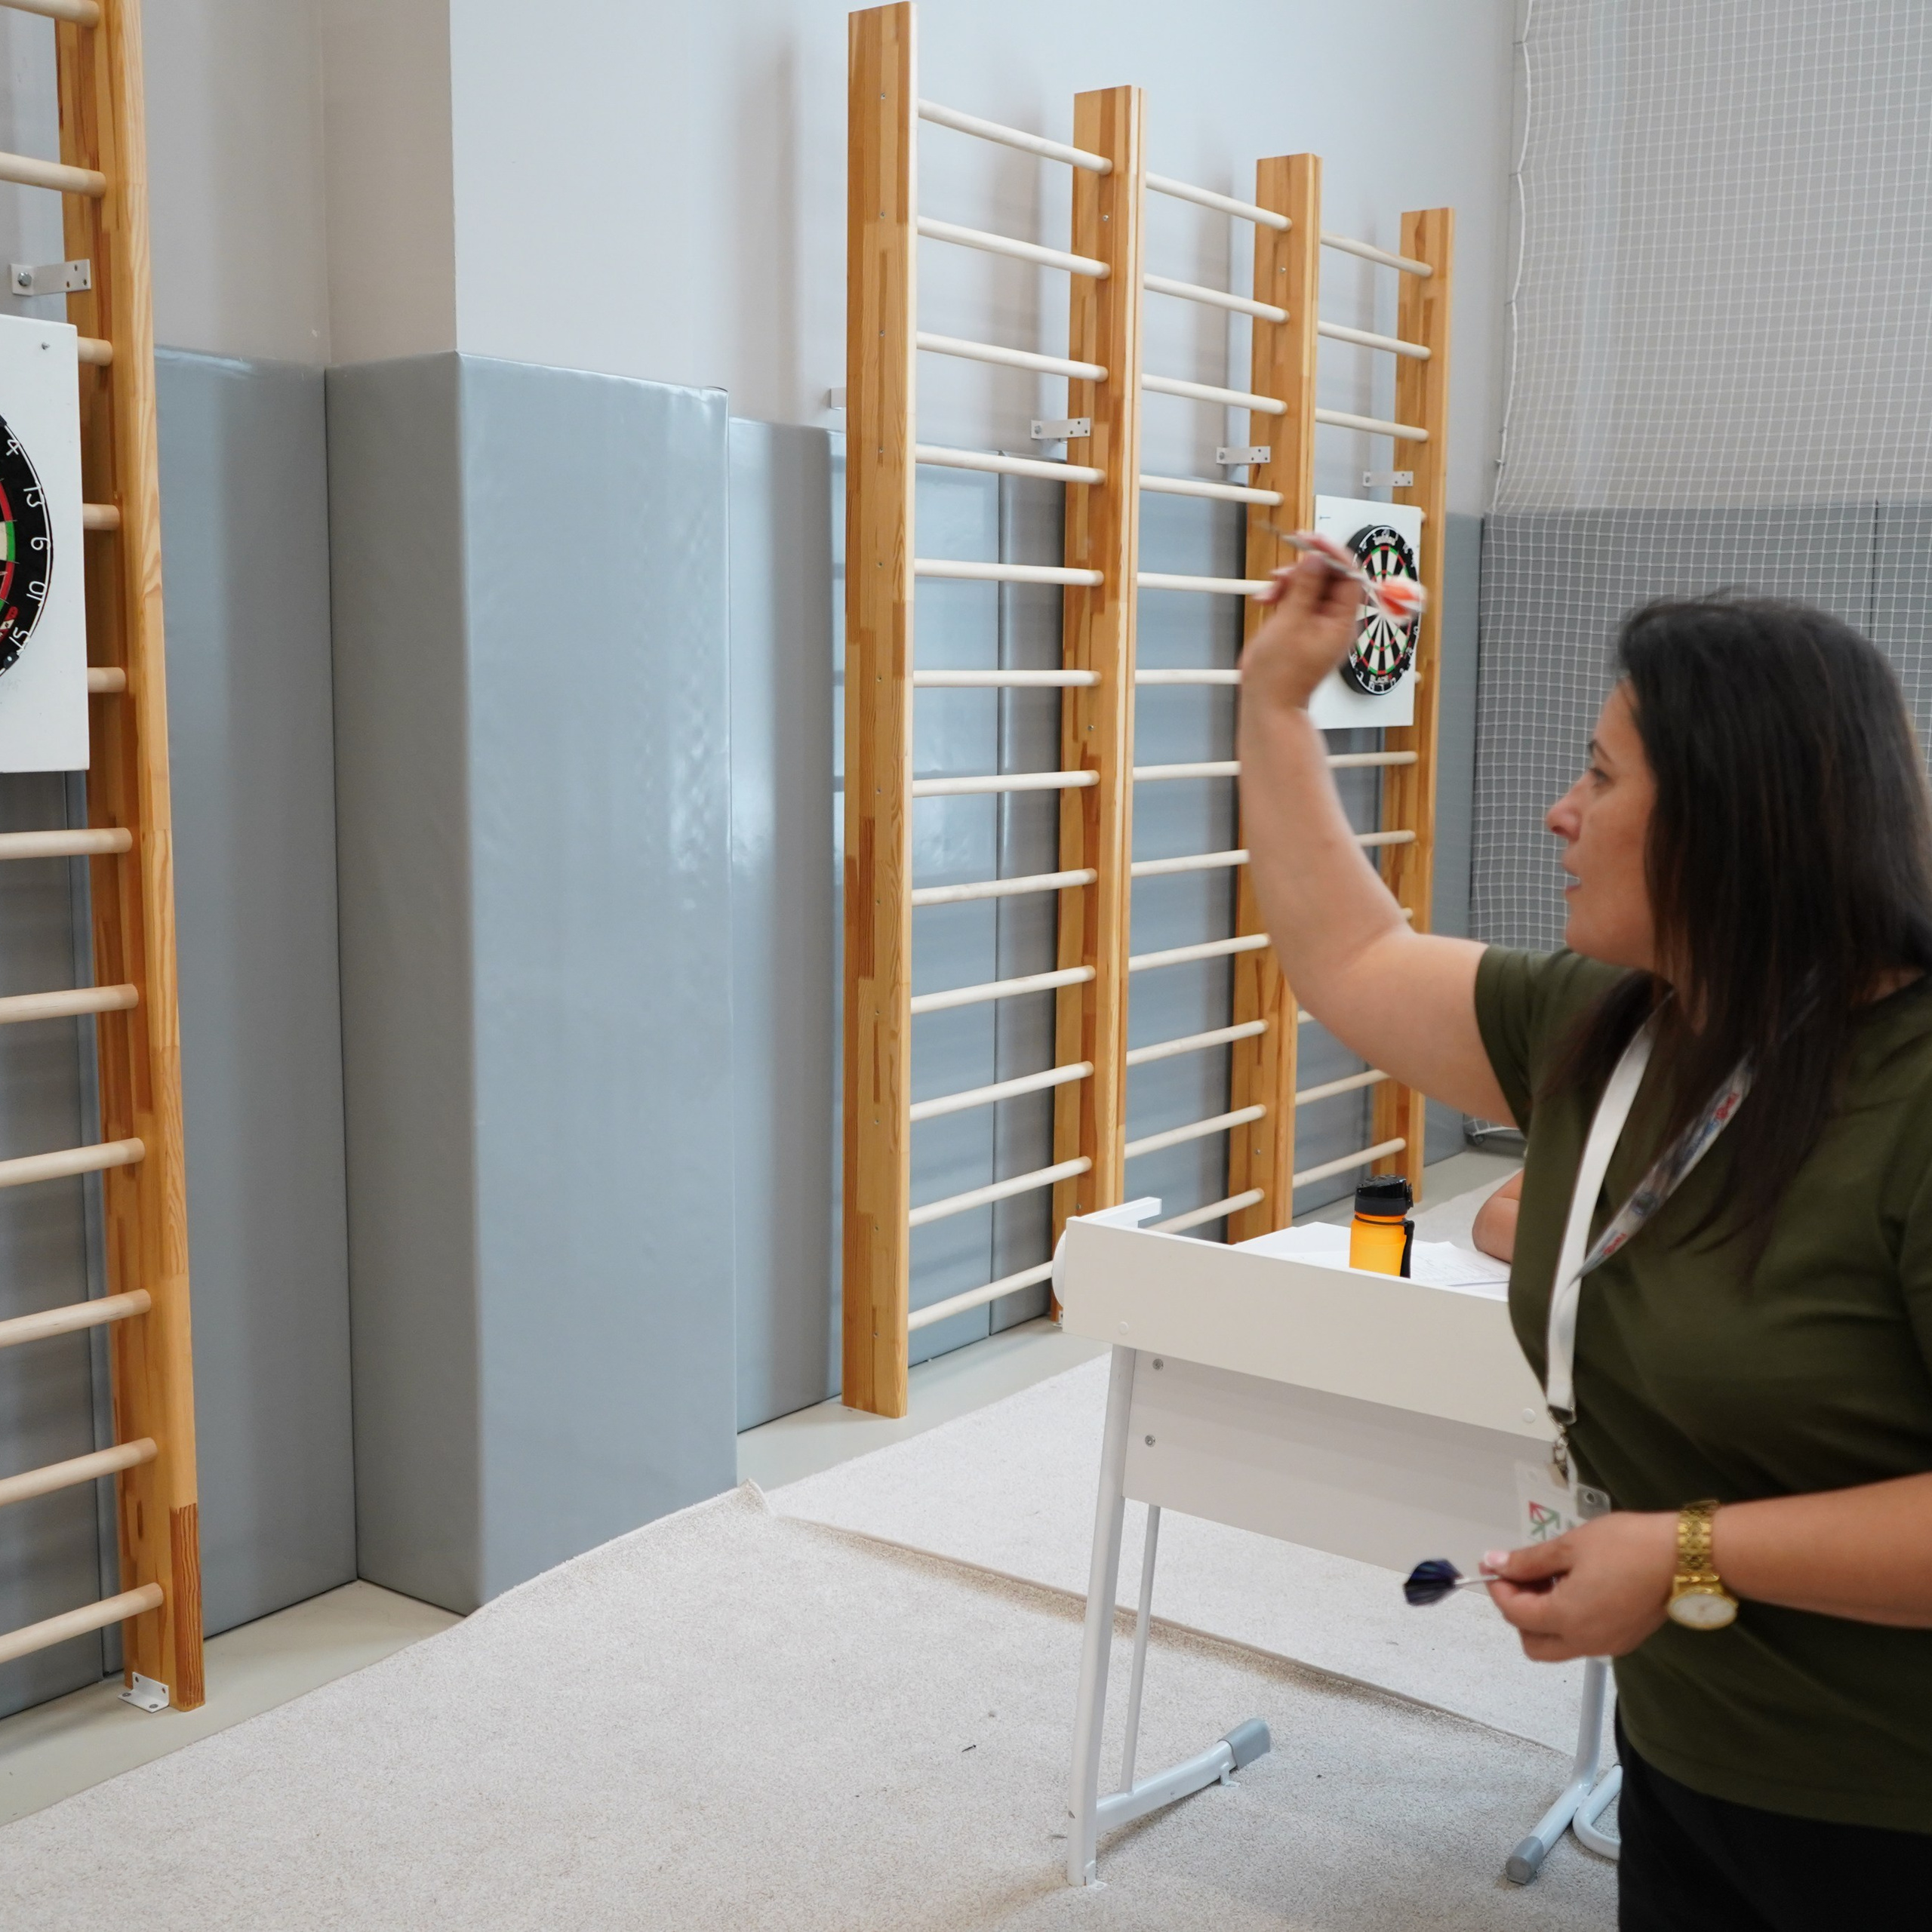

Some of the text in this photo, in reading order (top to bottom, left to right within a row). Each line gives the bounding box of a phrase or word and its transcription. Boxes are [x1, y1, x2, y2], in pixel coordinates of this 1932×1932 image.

[6, 438, 21, 456] 4
[23, 480, 45, 507] 13
[31, 537, 51, 550] 6
[26, 580, 47, 607] 10
[9, 626, 30, 655] 15
